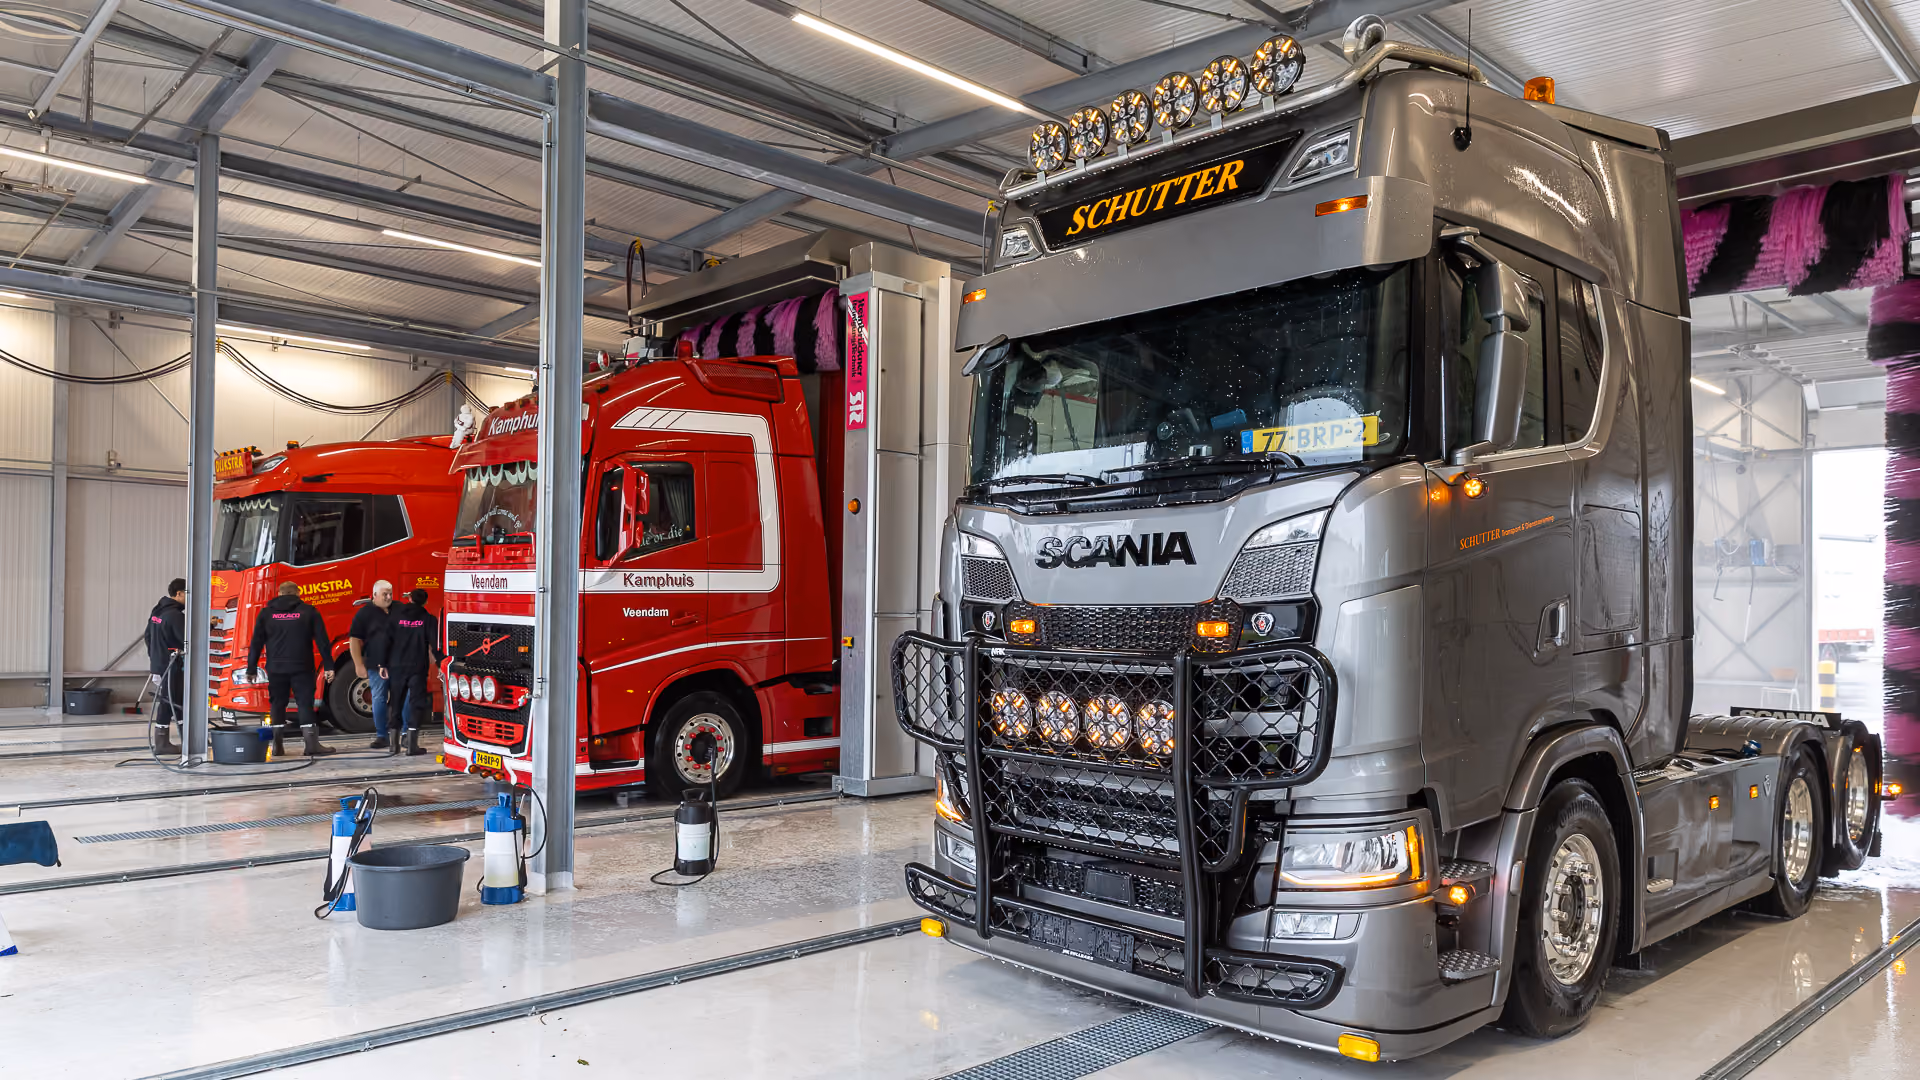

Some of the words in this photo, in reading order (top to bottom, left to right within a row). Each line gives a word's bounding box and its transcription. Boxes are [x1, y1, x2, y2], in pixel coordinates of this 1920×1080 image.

[1066, 159, 1245, 236] SCHUTTER
[488, 411, 540, 436] Kamphu
[1243, 441, 1251, 450] NL
[1262, 420, 1367, 453] 77-BRP-2
[215, 455, 244, 473] DIJKSTRA
[668, 523, 684, 540] die
[1460, 528, 1501, 551] SCHUTTER
[1034, 531, 1197, 569] SCANIA
[297, 578, 353, 596] DIJKSTRA
[471, 574, 508, 590] Veendam
[623, 572, 695, 589] Kamphuis
[622, 607, 669, 618] Veendam
